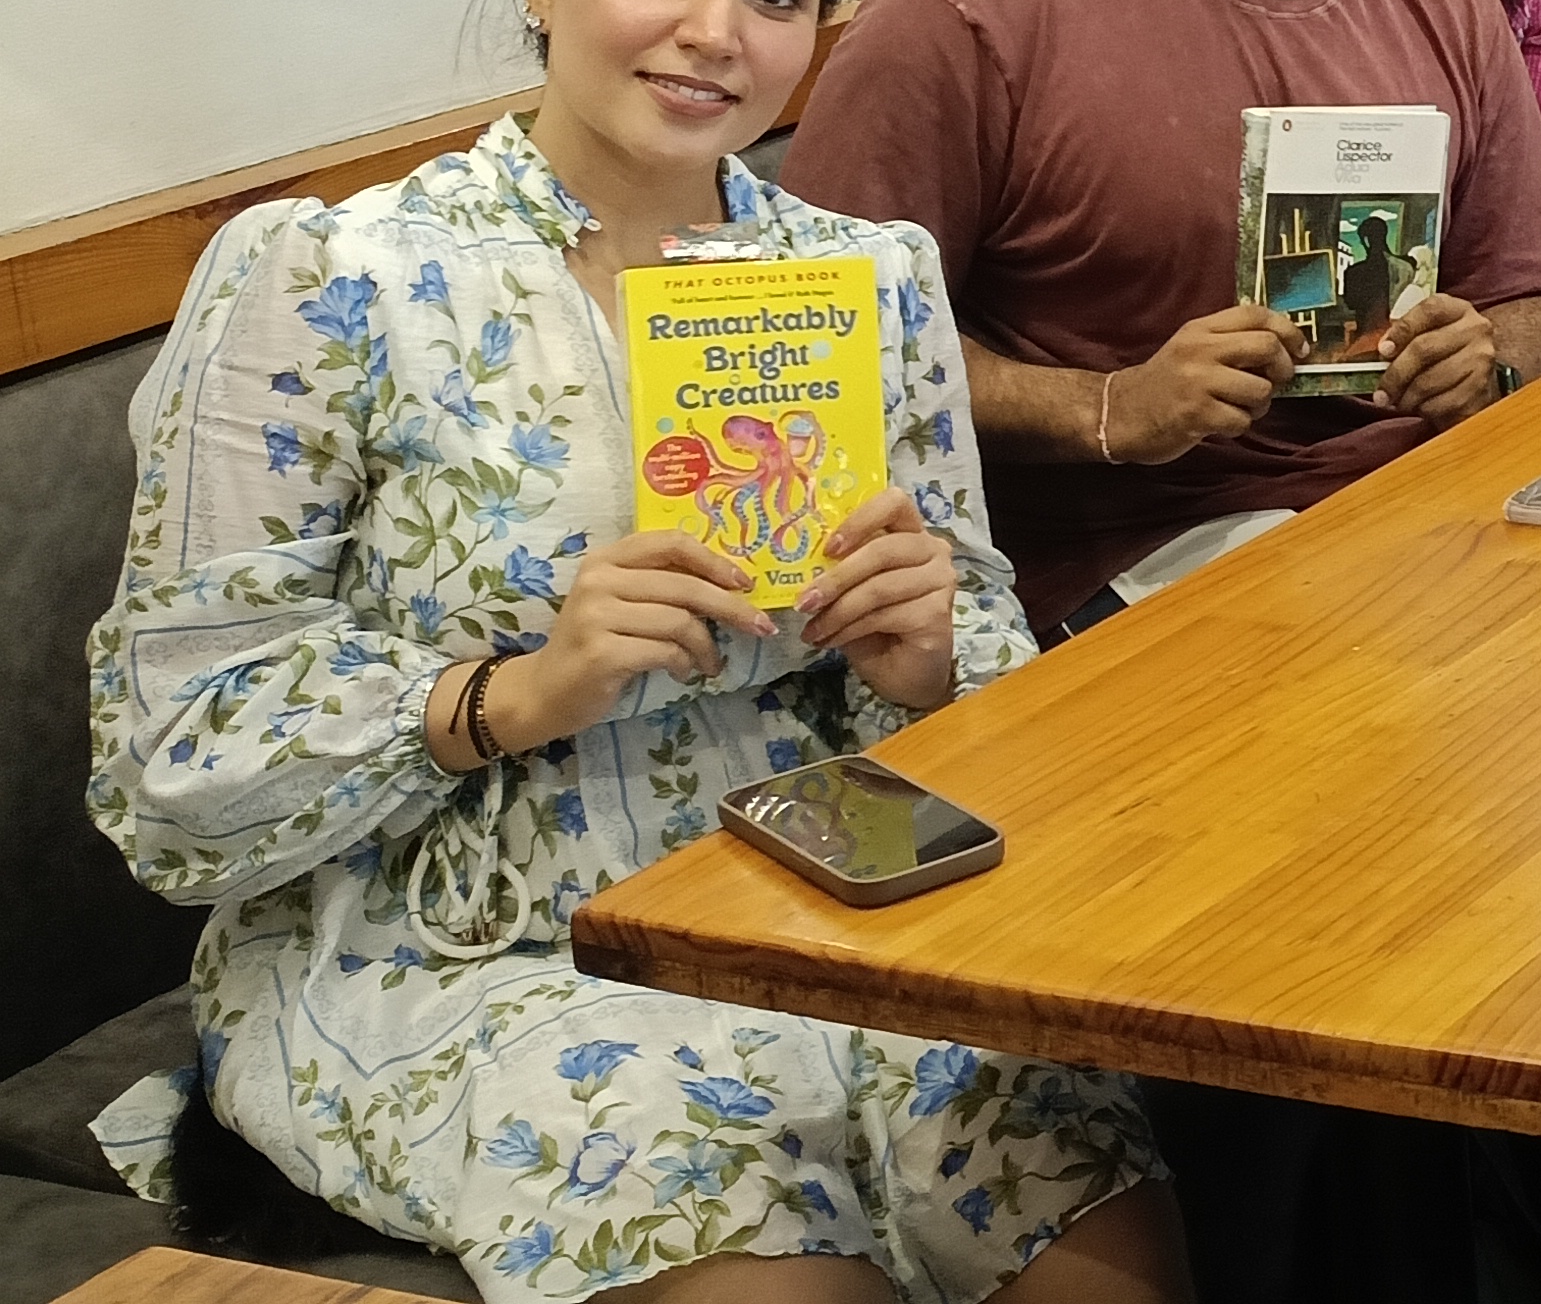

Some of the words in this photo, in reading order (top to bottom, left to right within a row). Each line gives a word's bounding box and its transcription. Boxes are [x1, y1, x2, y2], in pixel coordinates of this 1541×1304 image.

[1336, 139, 1382, 151] Clarice
[1336, 151, 1393, 163] Lispector
[664, 278, 705, 289] THAT
[712, 274, 787, 286] OCTOPUS
[796, 271, 841, 282] BOOK
[647, 303, 858, 340] Remarkably
[703, 341, 810, 381] Bright
[676, 380, 840, 410] Creatures
[764, 569, 803, 586] Van
